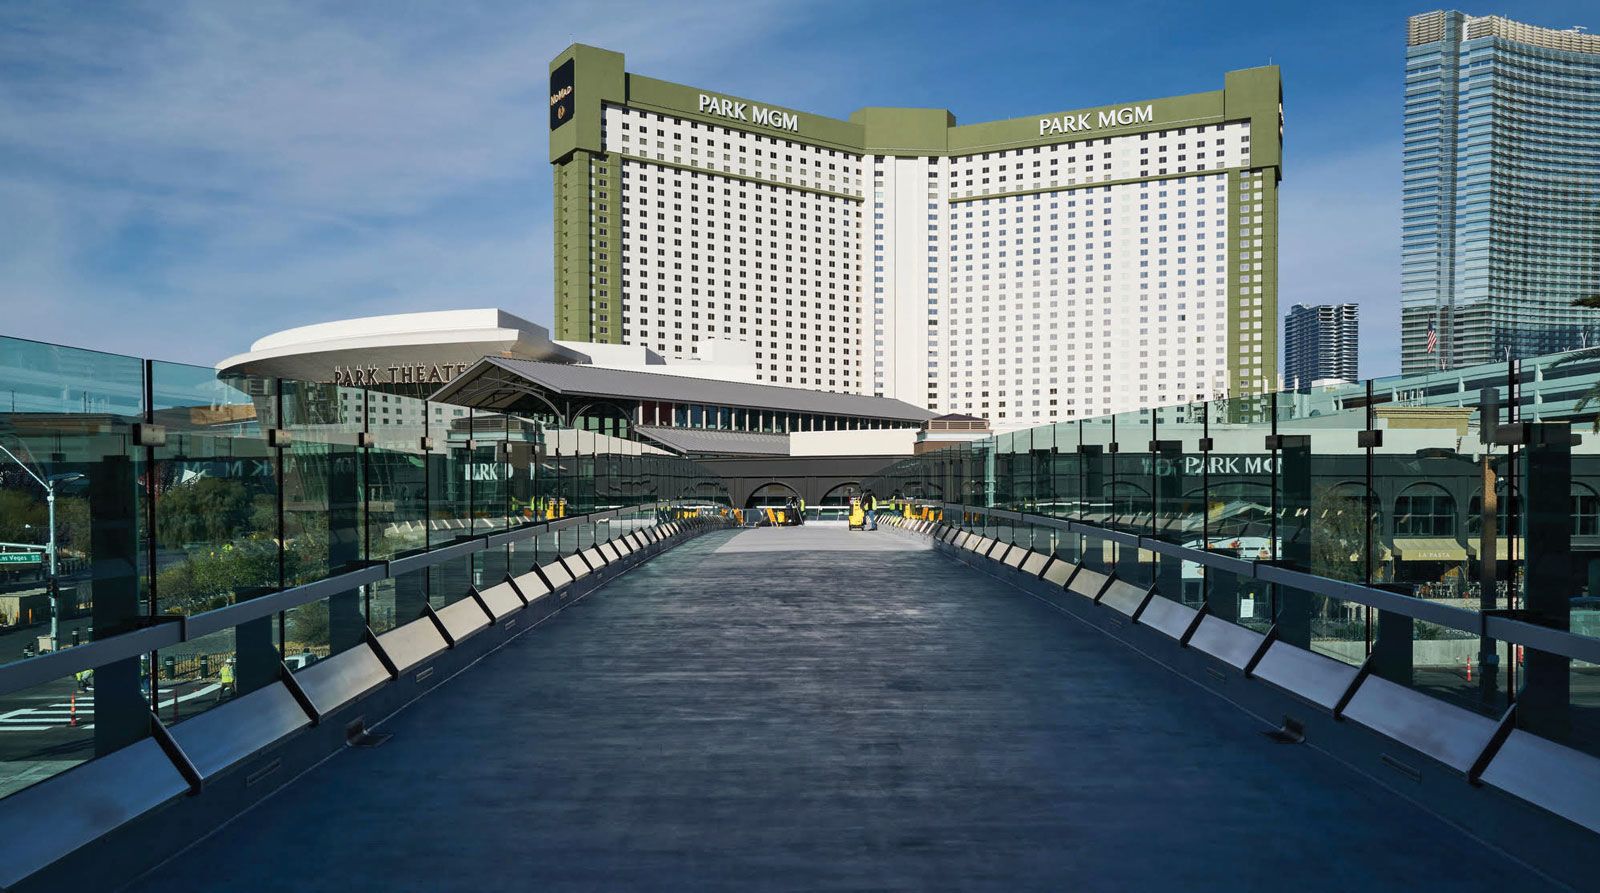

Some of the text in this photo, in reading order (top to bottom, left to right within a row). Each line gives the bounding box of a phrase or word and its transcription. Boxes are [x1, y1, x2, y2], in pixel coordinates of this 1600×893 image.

[699, 94, 799, 132] PARK MGM
[1040, 104, 1154, 136] PARK MGM
[335, 366, 380, 387] PARK
[1185, 457, 1240, 474] PARK
[9, 554, 27, 562] Vegas
